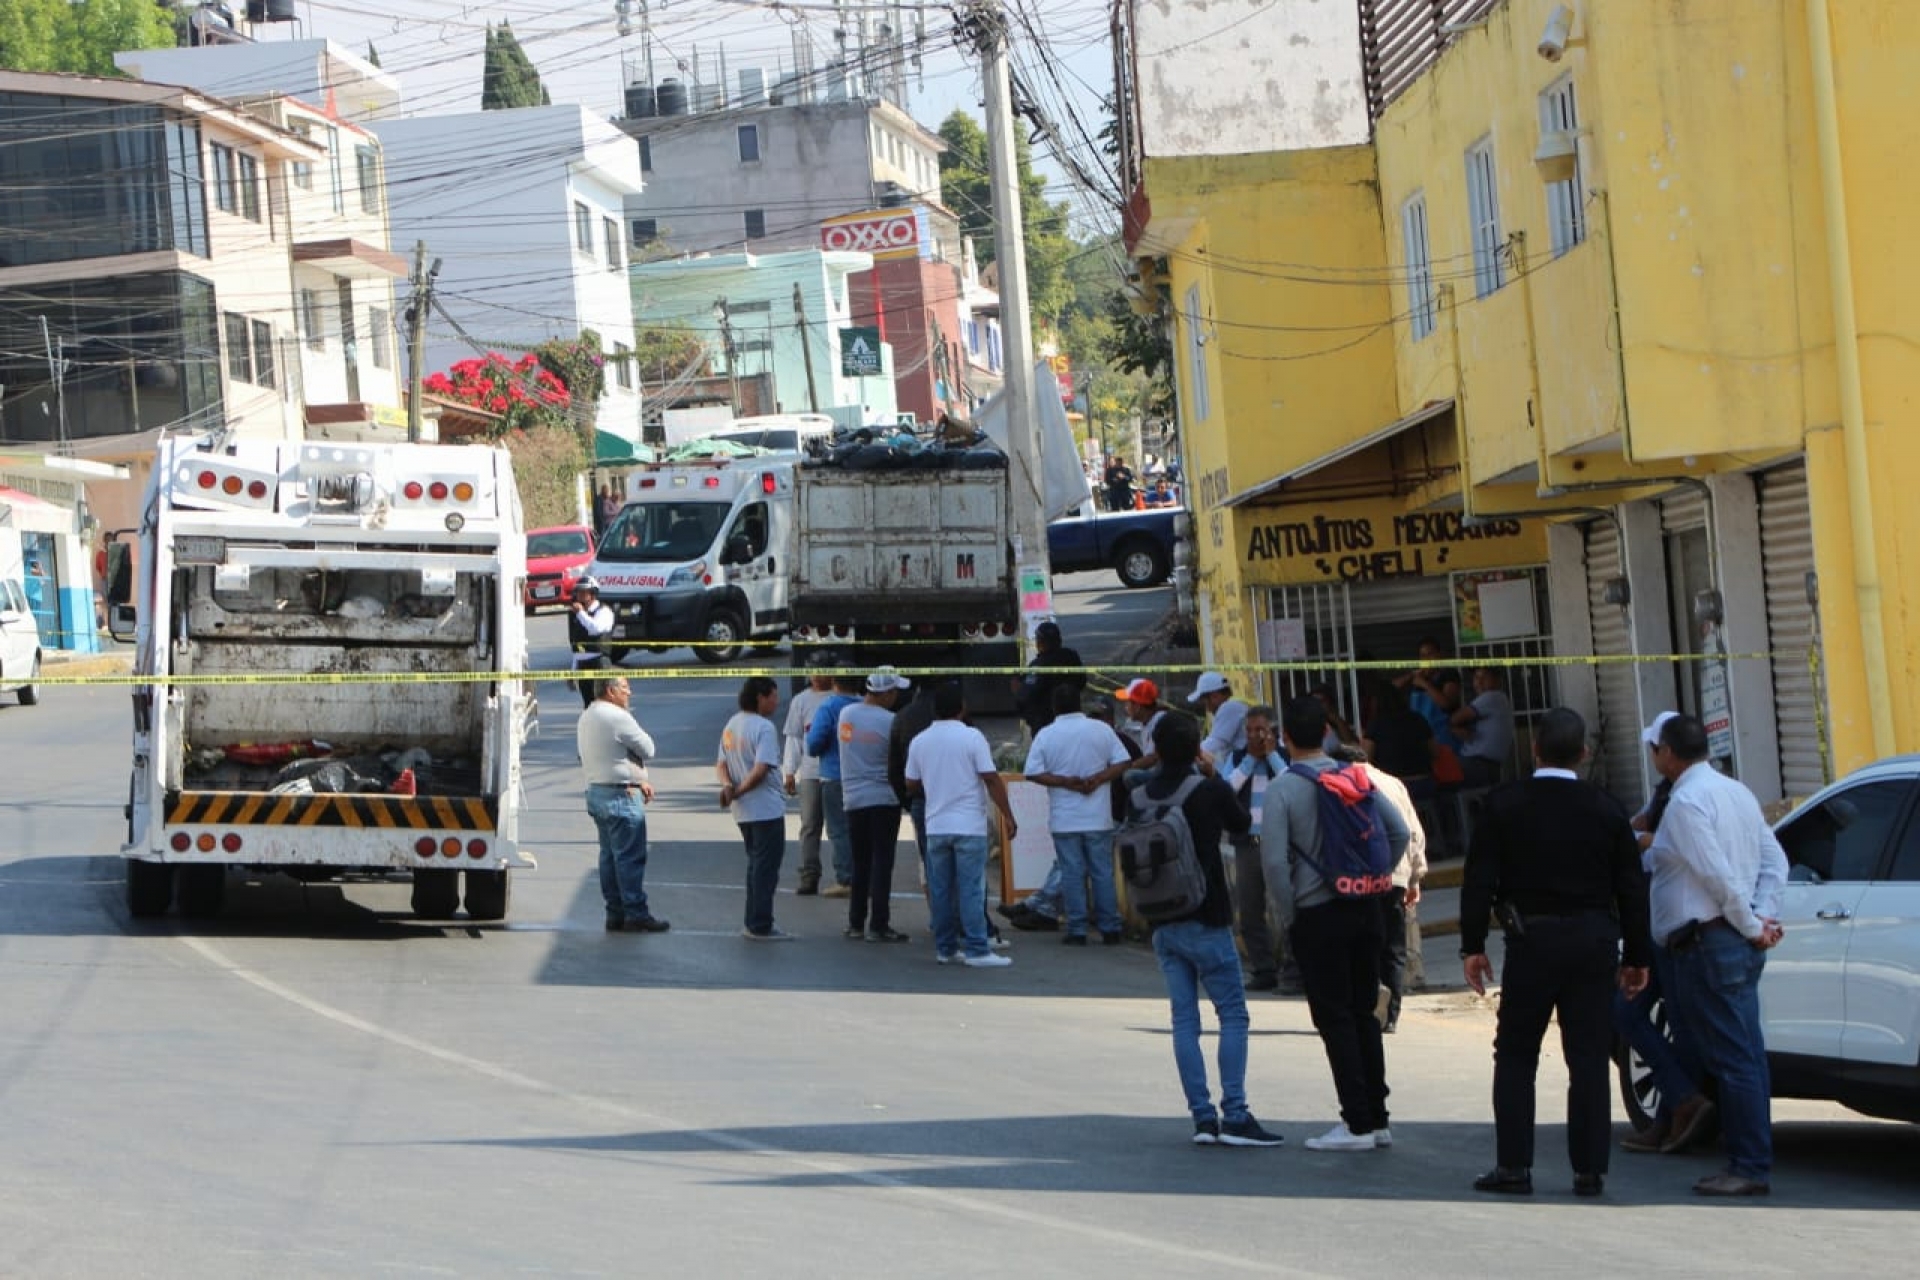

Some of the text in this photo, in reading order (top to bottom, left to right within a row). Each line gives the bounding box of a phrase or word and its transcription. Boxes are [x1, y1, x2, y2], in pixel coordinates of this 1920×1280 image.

[826, 219, 913, 251] OXXO
[1248, 515, 1374, 561] ANTOJITOS
[1338, 550, 1423, 579] CHELI
[1335, 875, 1393, 894] adida
